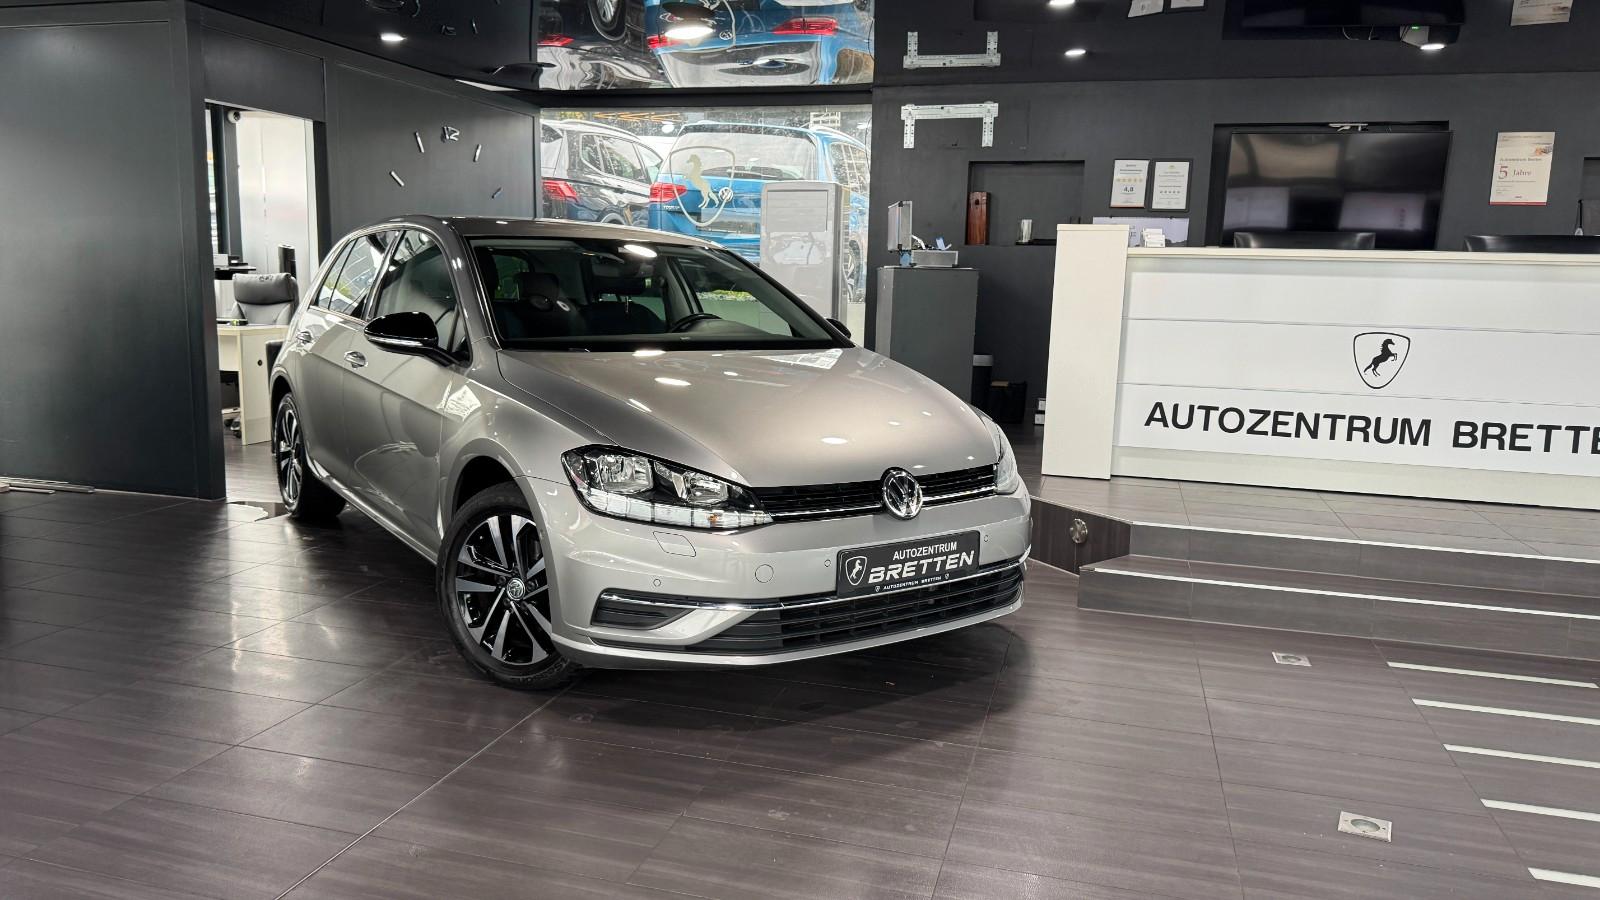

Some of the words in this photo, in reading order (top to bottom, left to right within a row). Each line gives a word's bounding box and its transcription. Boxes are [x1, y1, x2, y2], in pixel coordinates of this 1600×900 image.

[442, 126, 460, 142] 12
[1498, 165, 1509, 180] 5
[1144, 401, 1432, 447] AUTOZENTRUM
[893, 541, 957, 561] AUTOZENTRUM
[868, 550, 975, 584] BRETTEN
